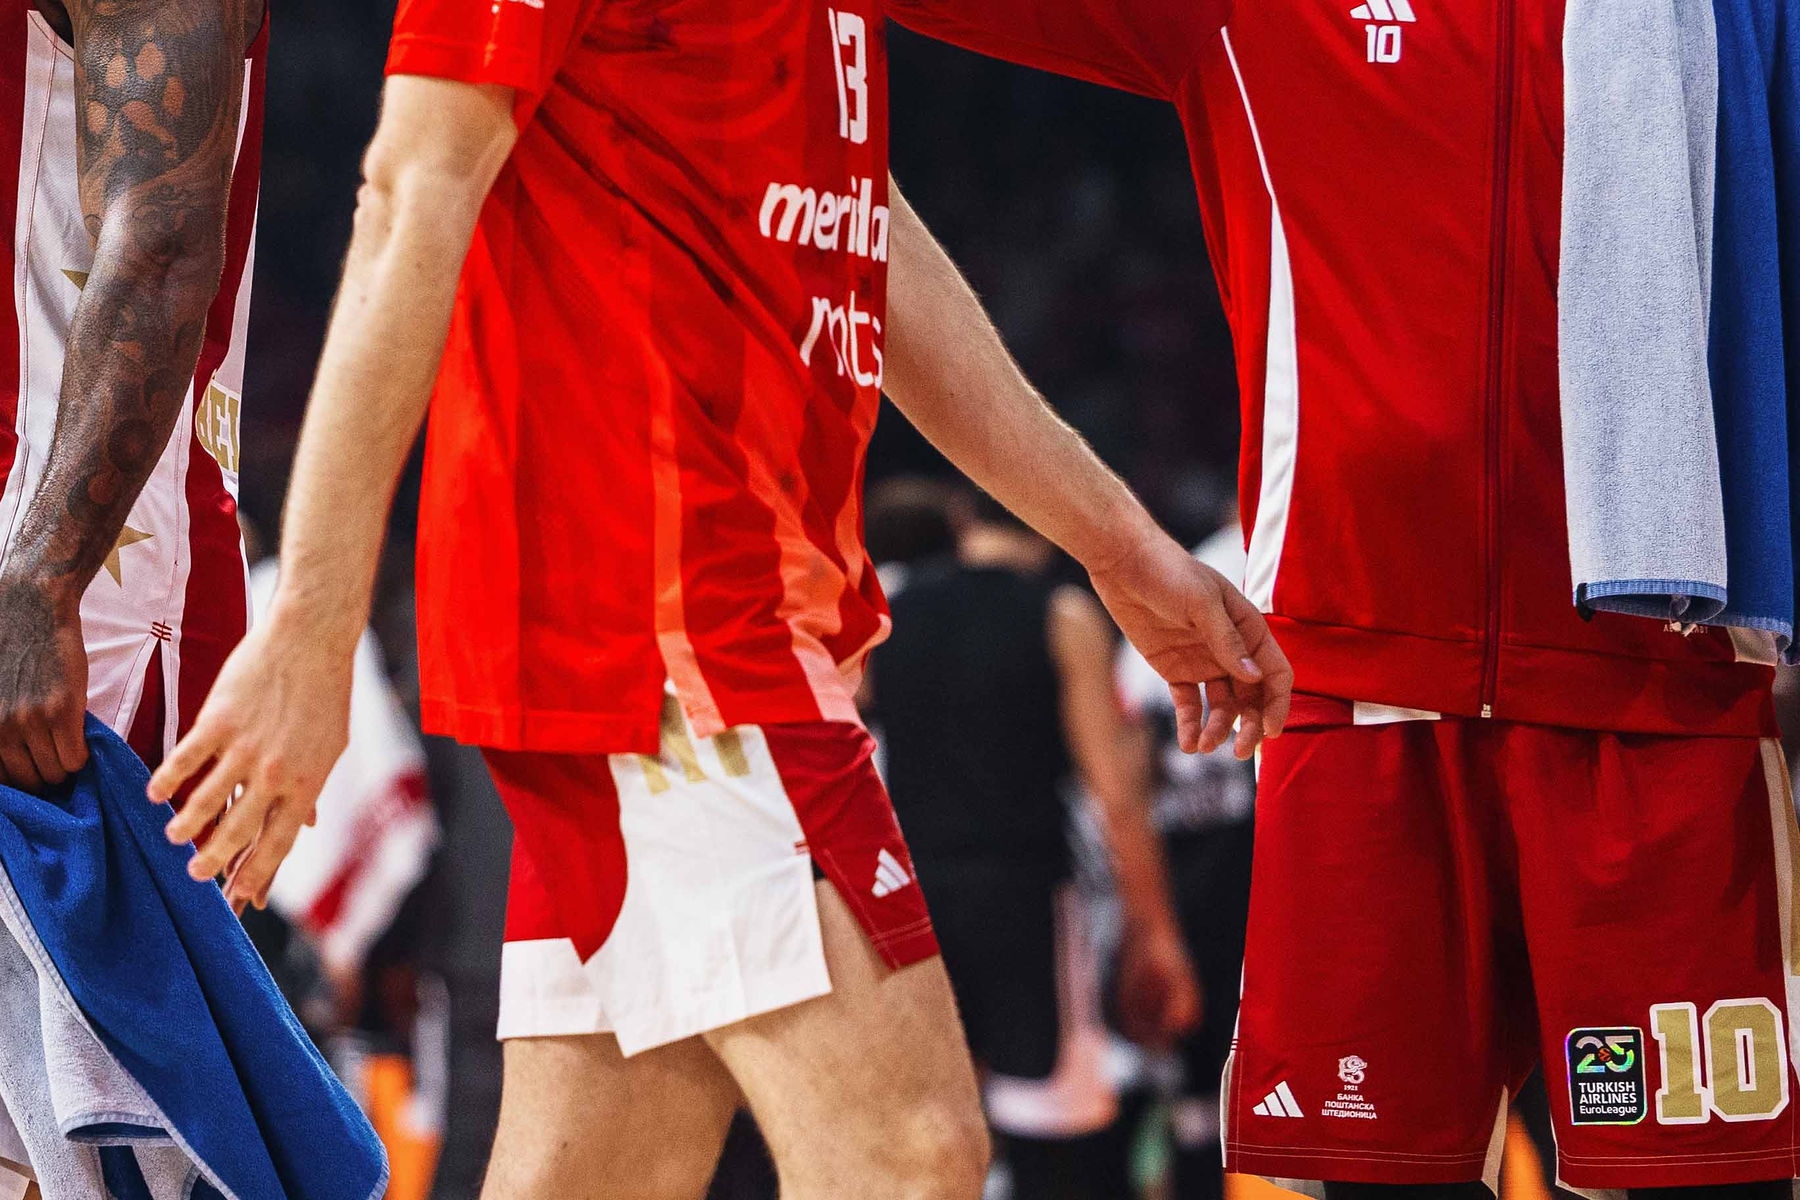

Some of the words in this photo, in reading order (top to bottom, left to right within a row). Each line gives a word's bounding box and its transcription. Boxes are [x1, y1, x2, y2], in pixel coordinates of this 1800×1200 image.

[1365, 24, 1402, 64] 10
[827, 7, 869, 145] 13
[1575, 1035, 1636, 1075] 25
[1649, 997, 1790, 1126] 10
[1343, 1084, 1359, 1092] 1921
[1578, 1080, 1636, 1094] TURKISH
[1337, 1093, 1365, 1102] БАНКА
[1579, 1092, 1637, 1106] AIRLINES
[1324, 1100, 1376, 1111] ПОШТАНСКА
[1579, 1104, 1638, 1117] EuroLeague
[1321, 1109, 1378, 1120] ШТЕДИОНИЦА
